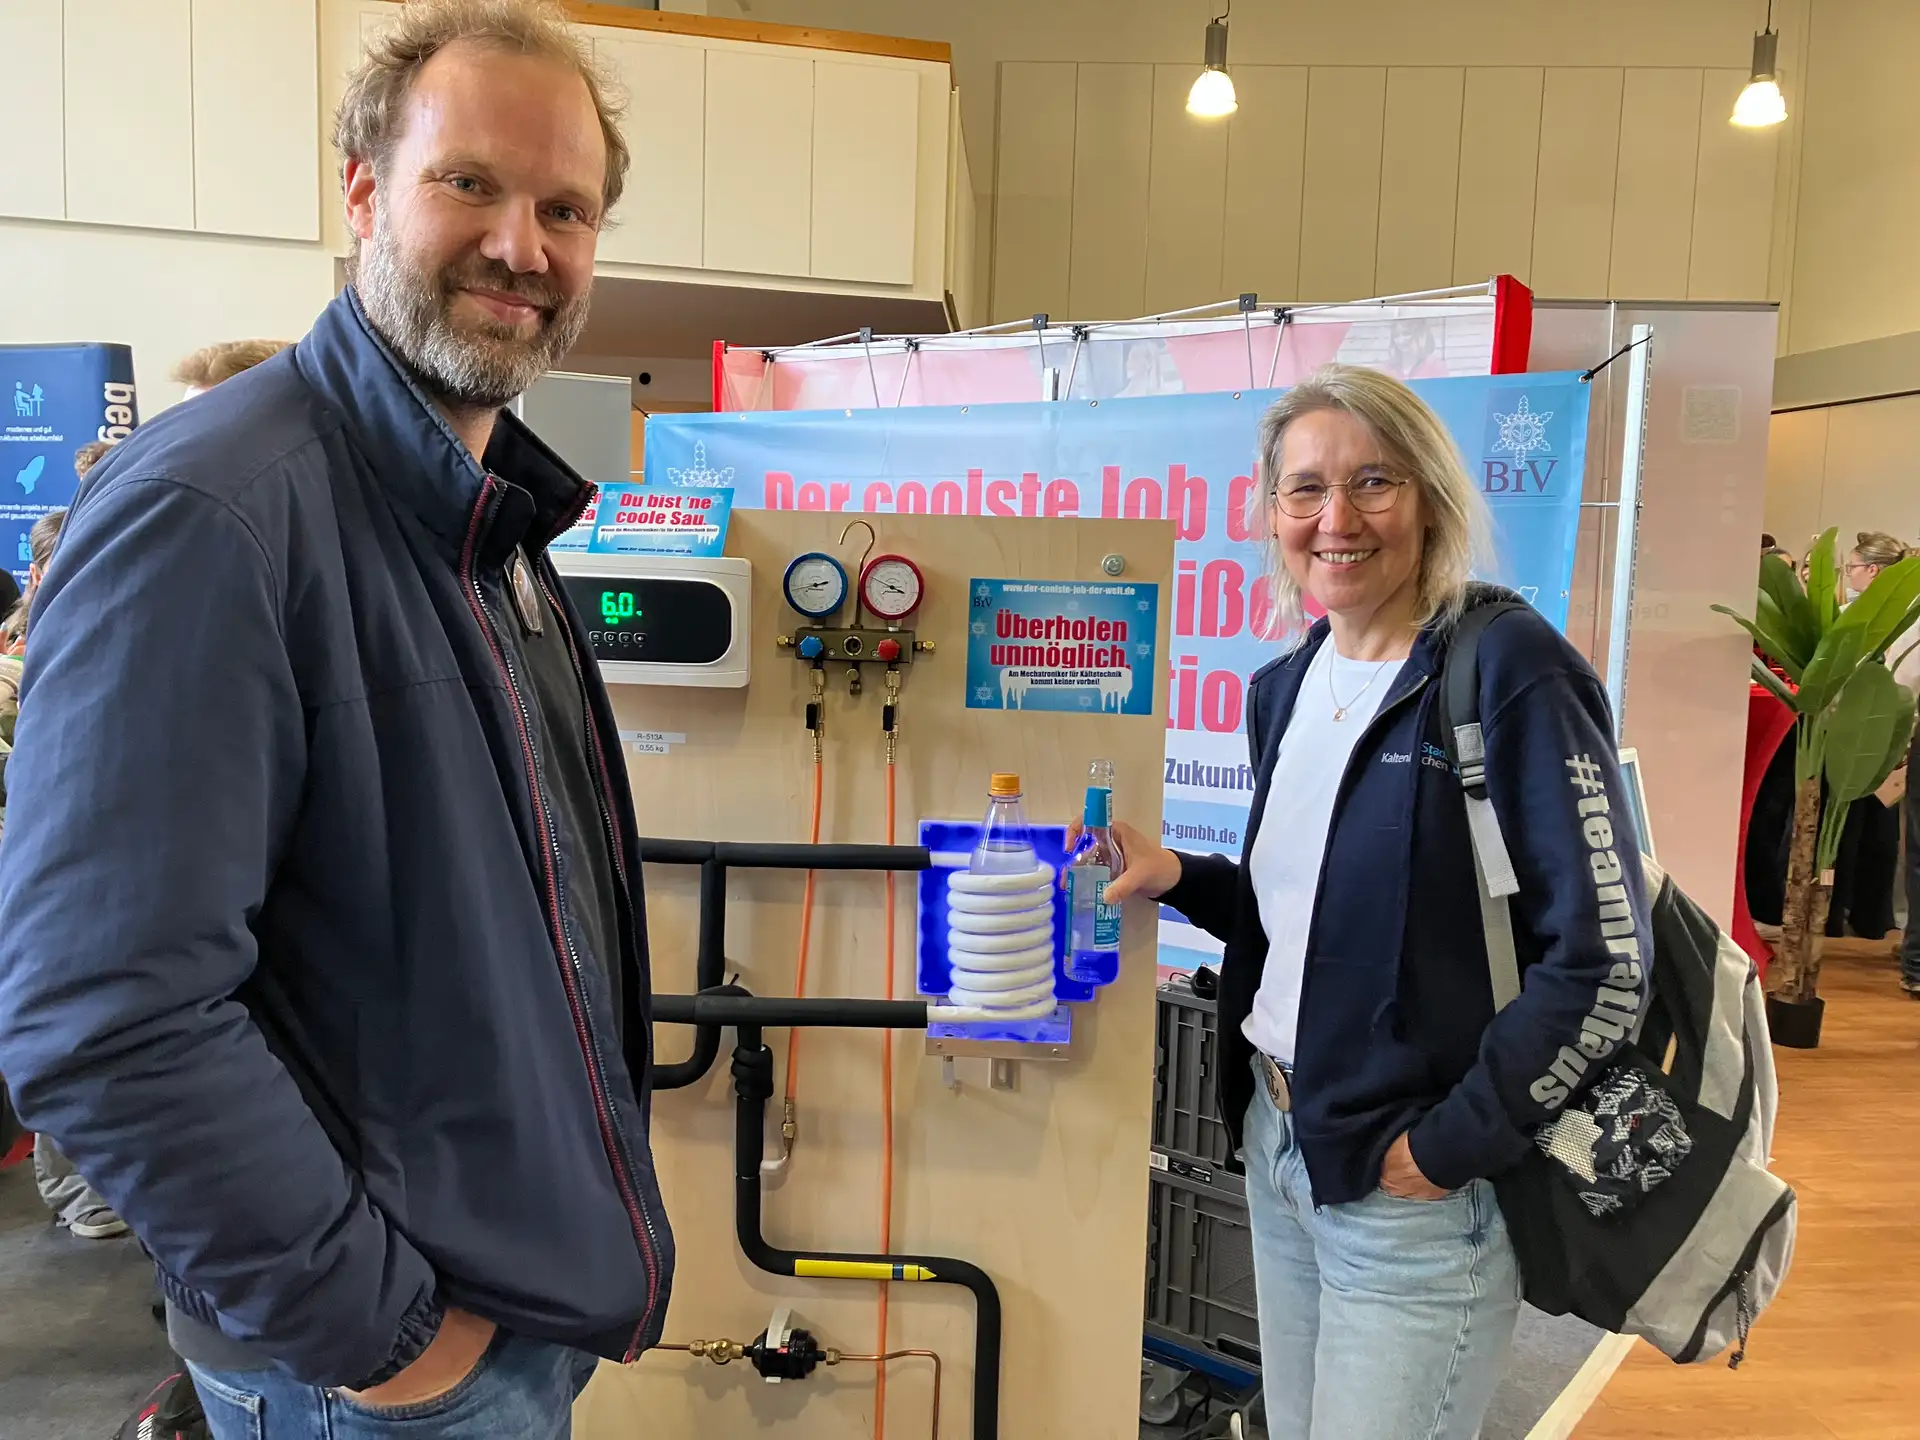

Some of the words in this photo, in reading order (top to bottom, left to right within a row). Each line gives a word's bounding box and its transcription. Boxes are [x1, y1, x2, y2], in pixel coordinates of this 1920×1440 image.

[620, 493, 644, 507] Du
[647, 494, 682, 508] bist
[615, 510, 666, 524] coole
[670, 511, 707, 525] Sau.
[996, 609, 1127, 642] Überholen
[1020, 670, 1068, 678] Mechatroniker
[1069, 670, 1079, 678] für
[1080, 670, 1122, 678] Kältetechnik
[637, 733, 664, 741] R-513A
[655, 745, 664, 753] kg
[1164, 758, 1255, 791] Zukunft
[1529, 753, 1642, 1110] #teamrathaus
